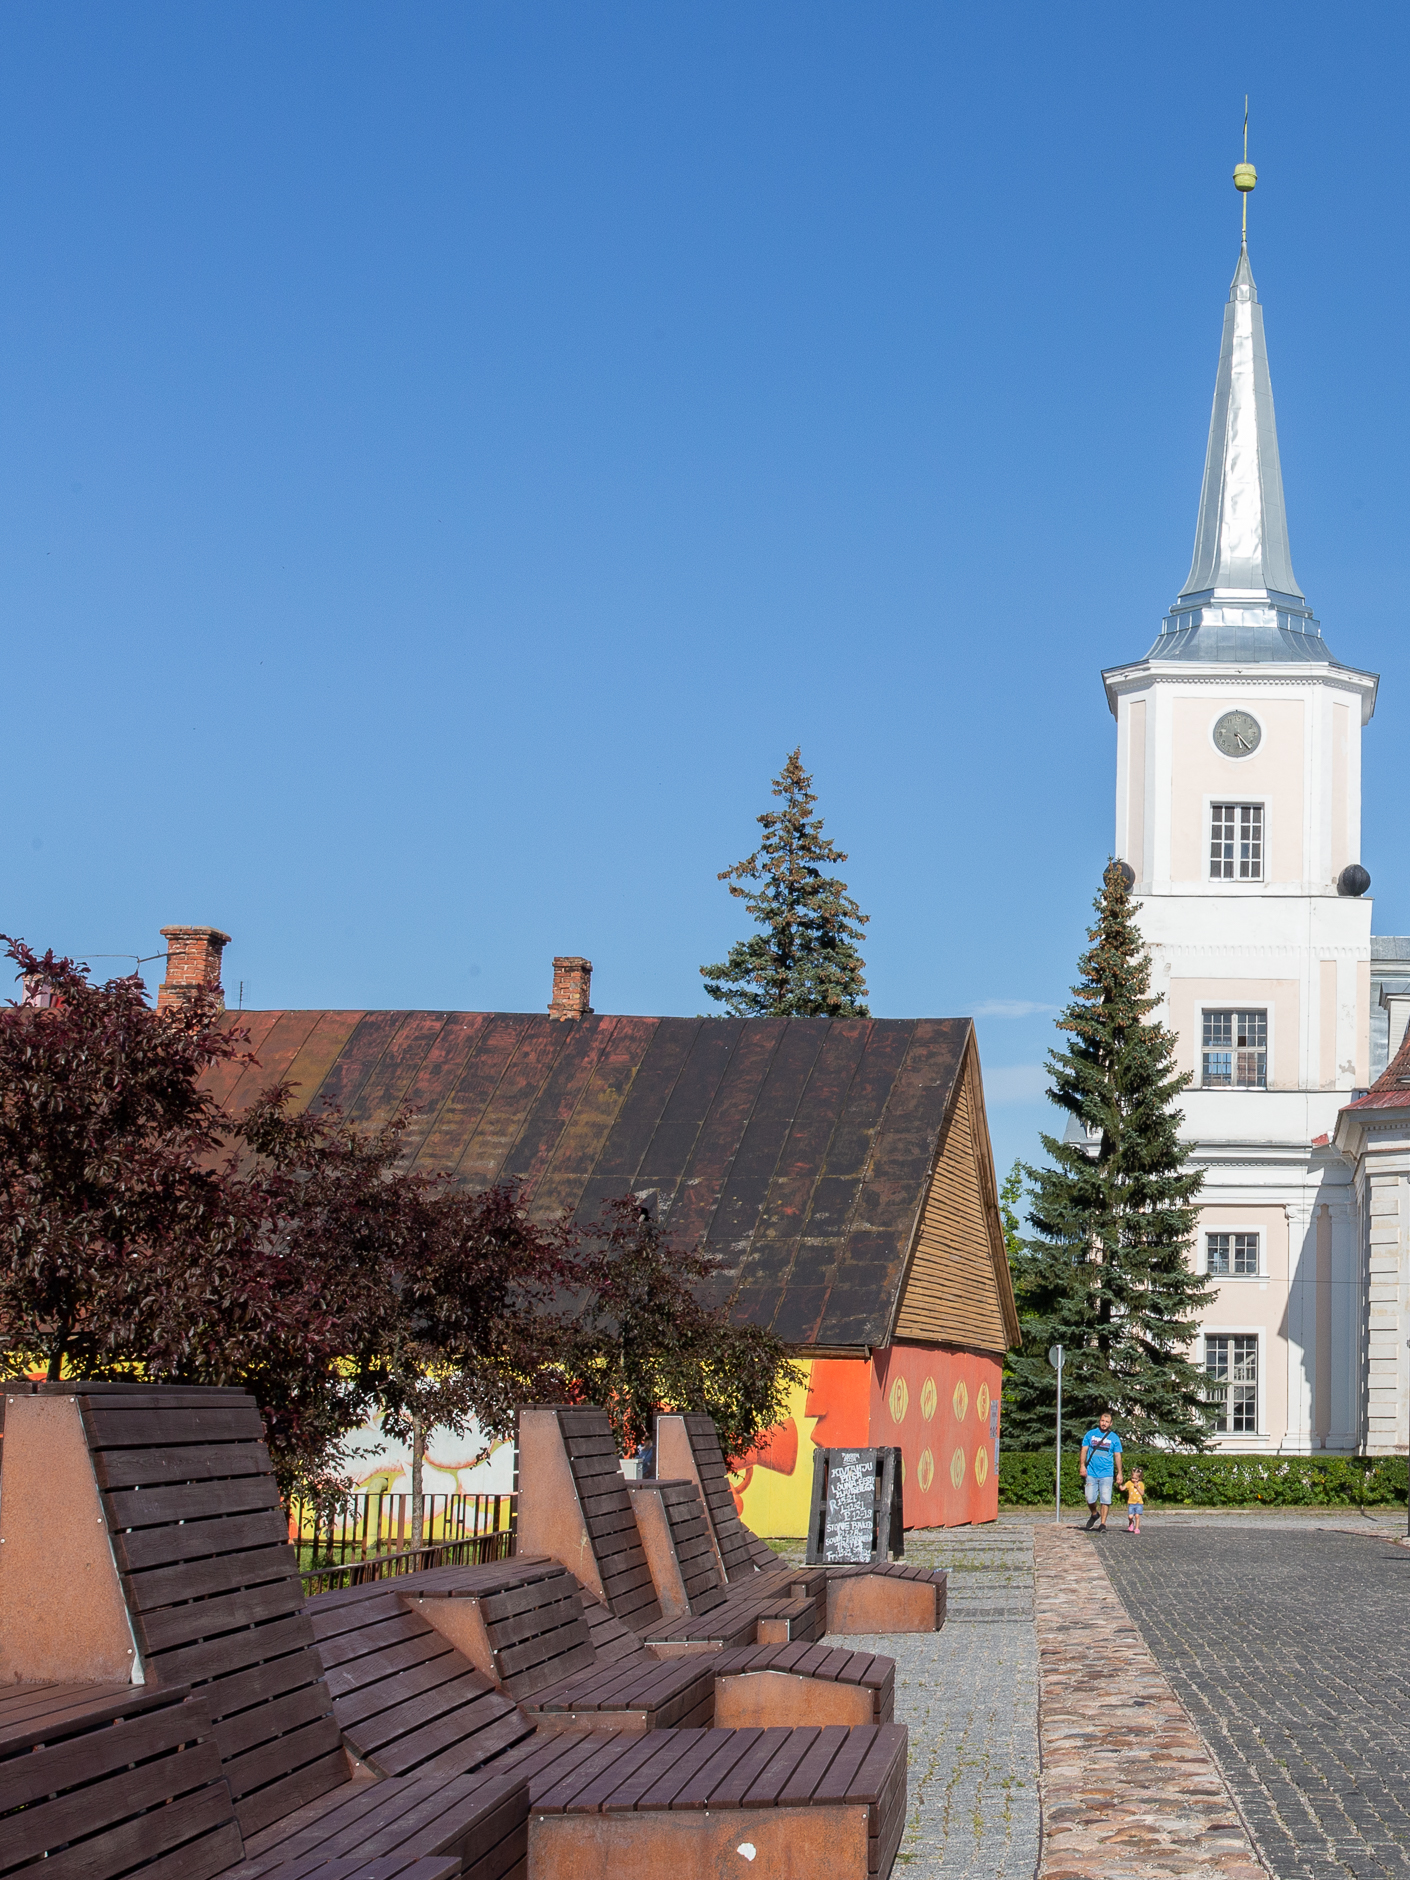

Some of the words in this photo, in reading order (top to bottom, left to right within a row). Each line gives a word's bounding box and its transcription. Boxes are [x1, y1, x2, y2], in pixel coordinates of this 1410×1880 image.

[840, 1471, 863, 1483] PITSA
[829, 1499, 839, 1514] R
[852, 1509, 873, 1520] 12-18
[826, 1522, 850, 1532] STONE
